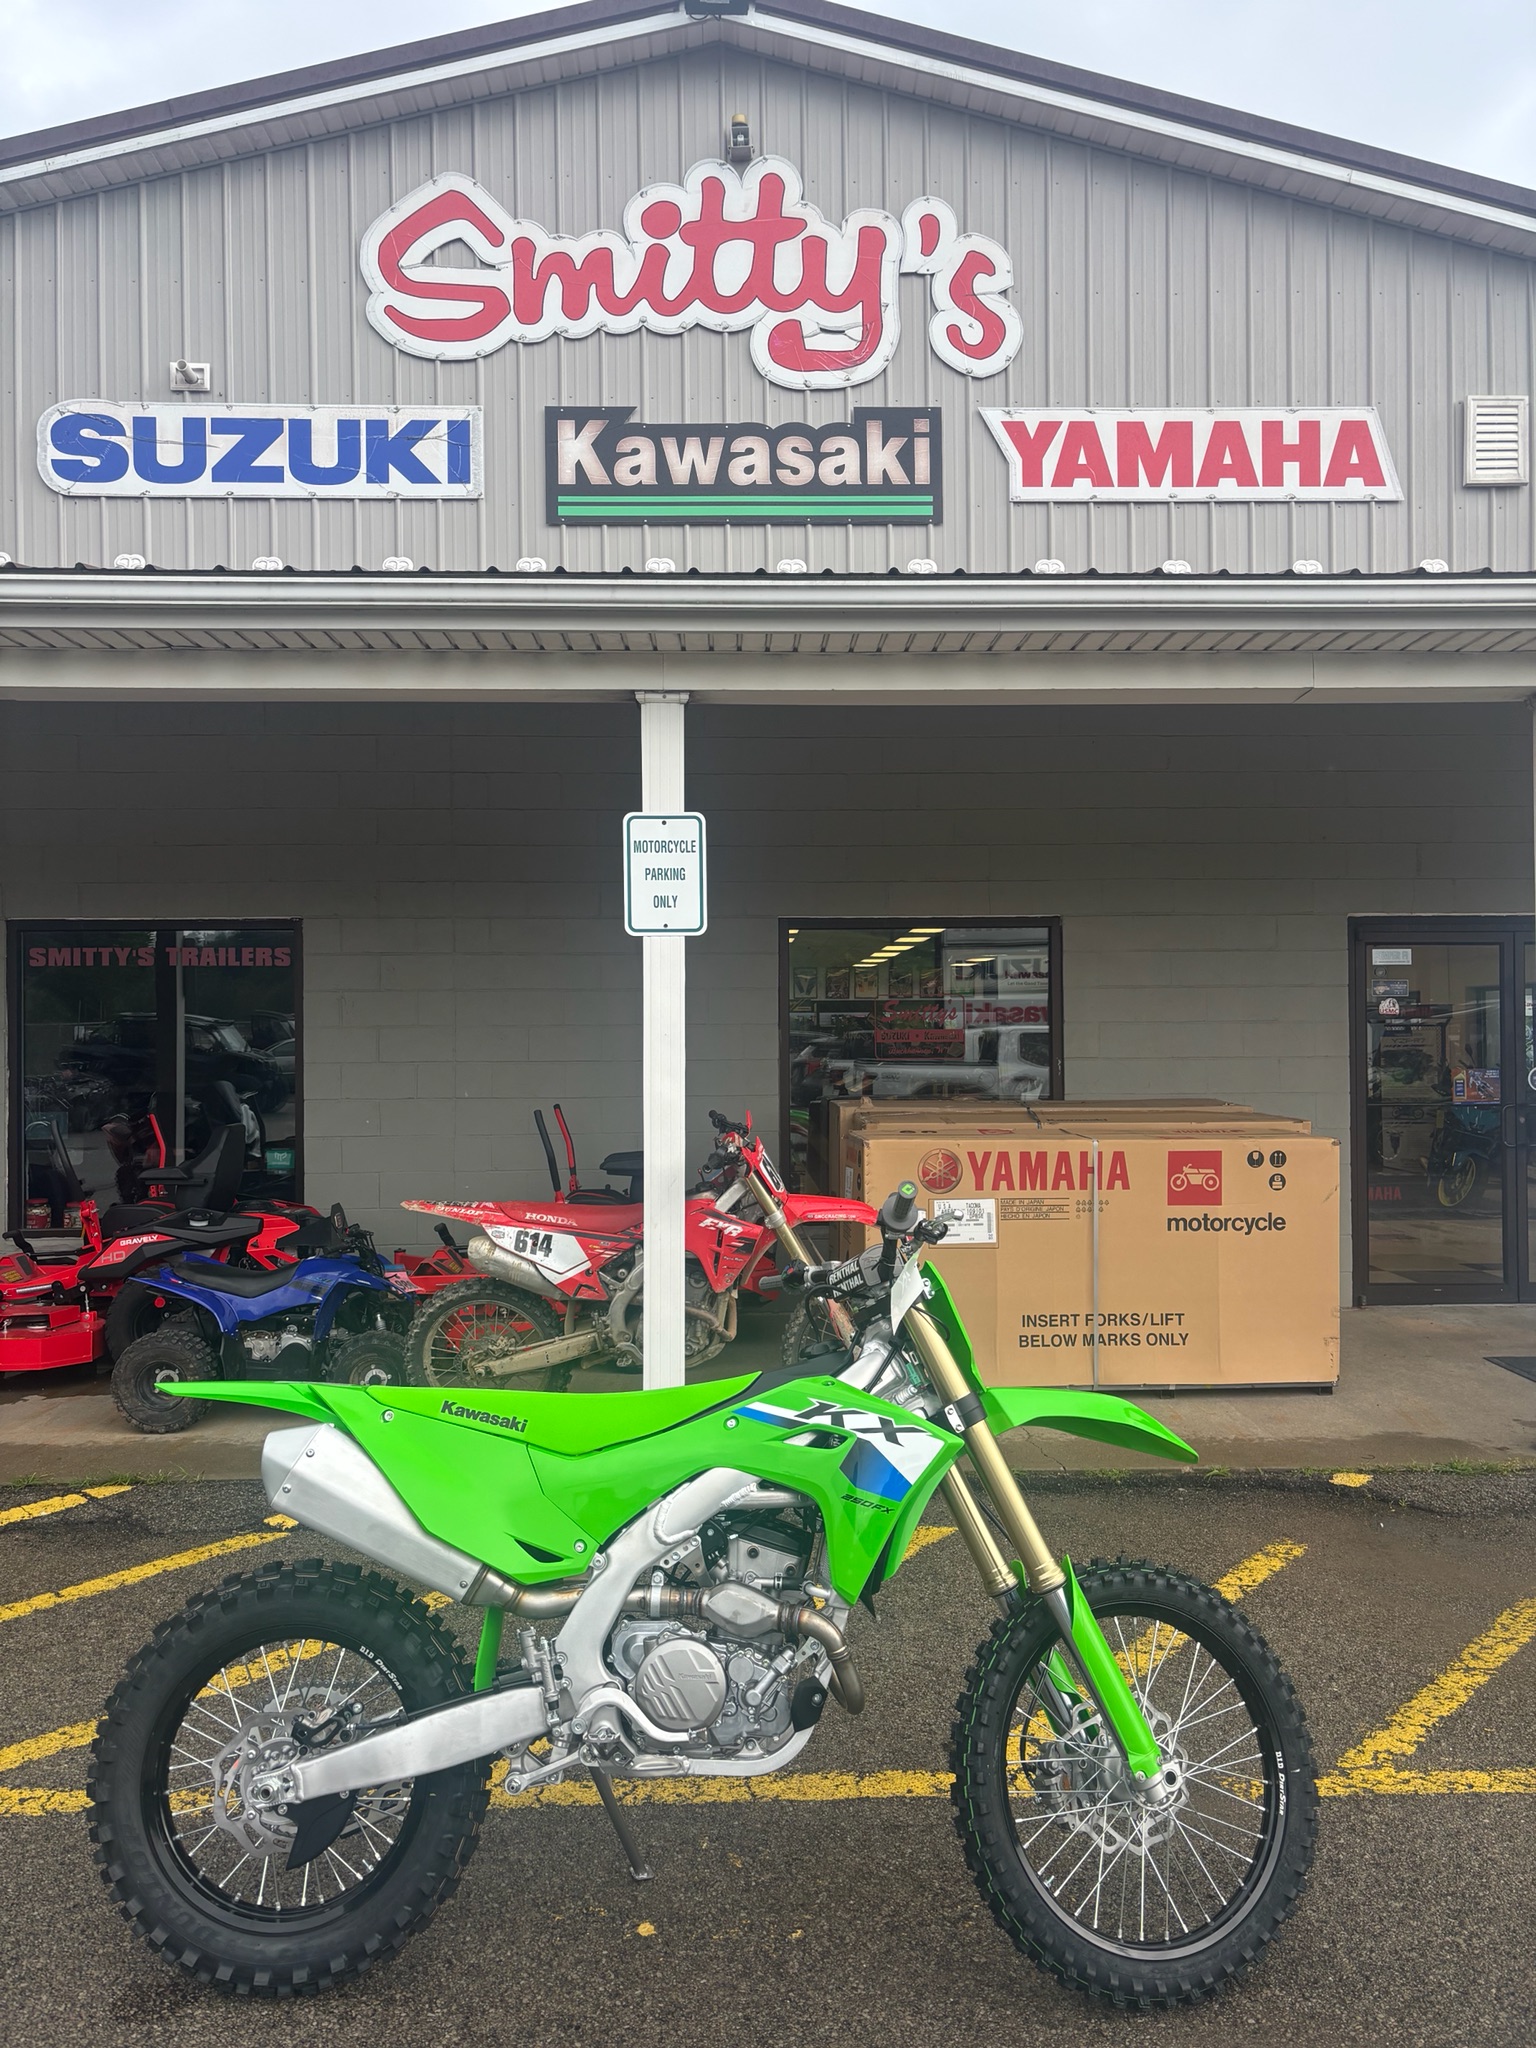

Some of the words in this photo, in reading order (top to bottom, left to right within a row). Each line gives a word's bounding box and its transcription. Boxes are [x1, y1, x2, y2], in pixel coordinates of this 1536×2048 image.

[377, 172, 1008, 373] Smitty's
[49, 412, 472, 486] SUZUKI
[556, 418, 931, 487] Kawasaki
[1001, 420, 1387, 488] YAMAHA
[633, 840, 697, 854] MOTORCYCLE
[644, 867, 686, 881] PARKING
[653, 895, 678, 908] ONLY
[29, 947, 155, 967] SMITTY'S
[165, 947, 292, 967] TRAILERS
[881, 1031, 910, 1040] SUZUKI
[967, 1150, 1131, 1192] YAMAHA
[436, 1205, 484, 1217] DUNLOP
[524, 1212, 579, 1227] HONDA
[1167, 1212, 1287, 1236] motorcycle
[119, 1234, 159, 1247] GRAVELY
[513, 1229, 553, 1258] 614
[101, 1250, 126, 1264] HD
[829, 1260, 860, 1285] RENTHAL
[1021, 1314, 1080, 1328] INSERT
[1019, 1334, 1077, 1348] BELOW
[1082, 1333, 1141, 1347] MARKS
[1146, 1333, 1189, 1347] ONLY
[440, 1400, 529, 1433] Kawasaki
[793, 1399, 928, 1448] KX
